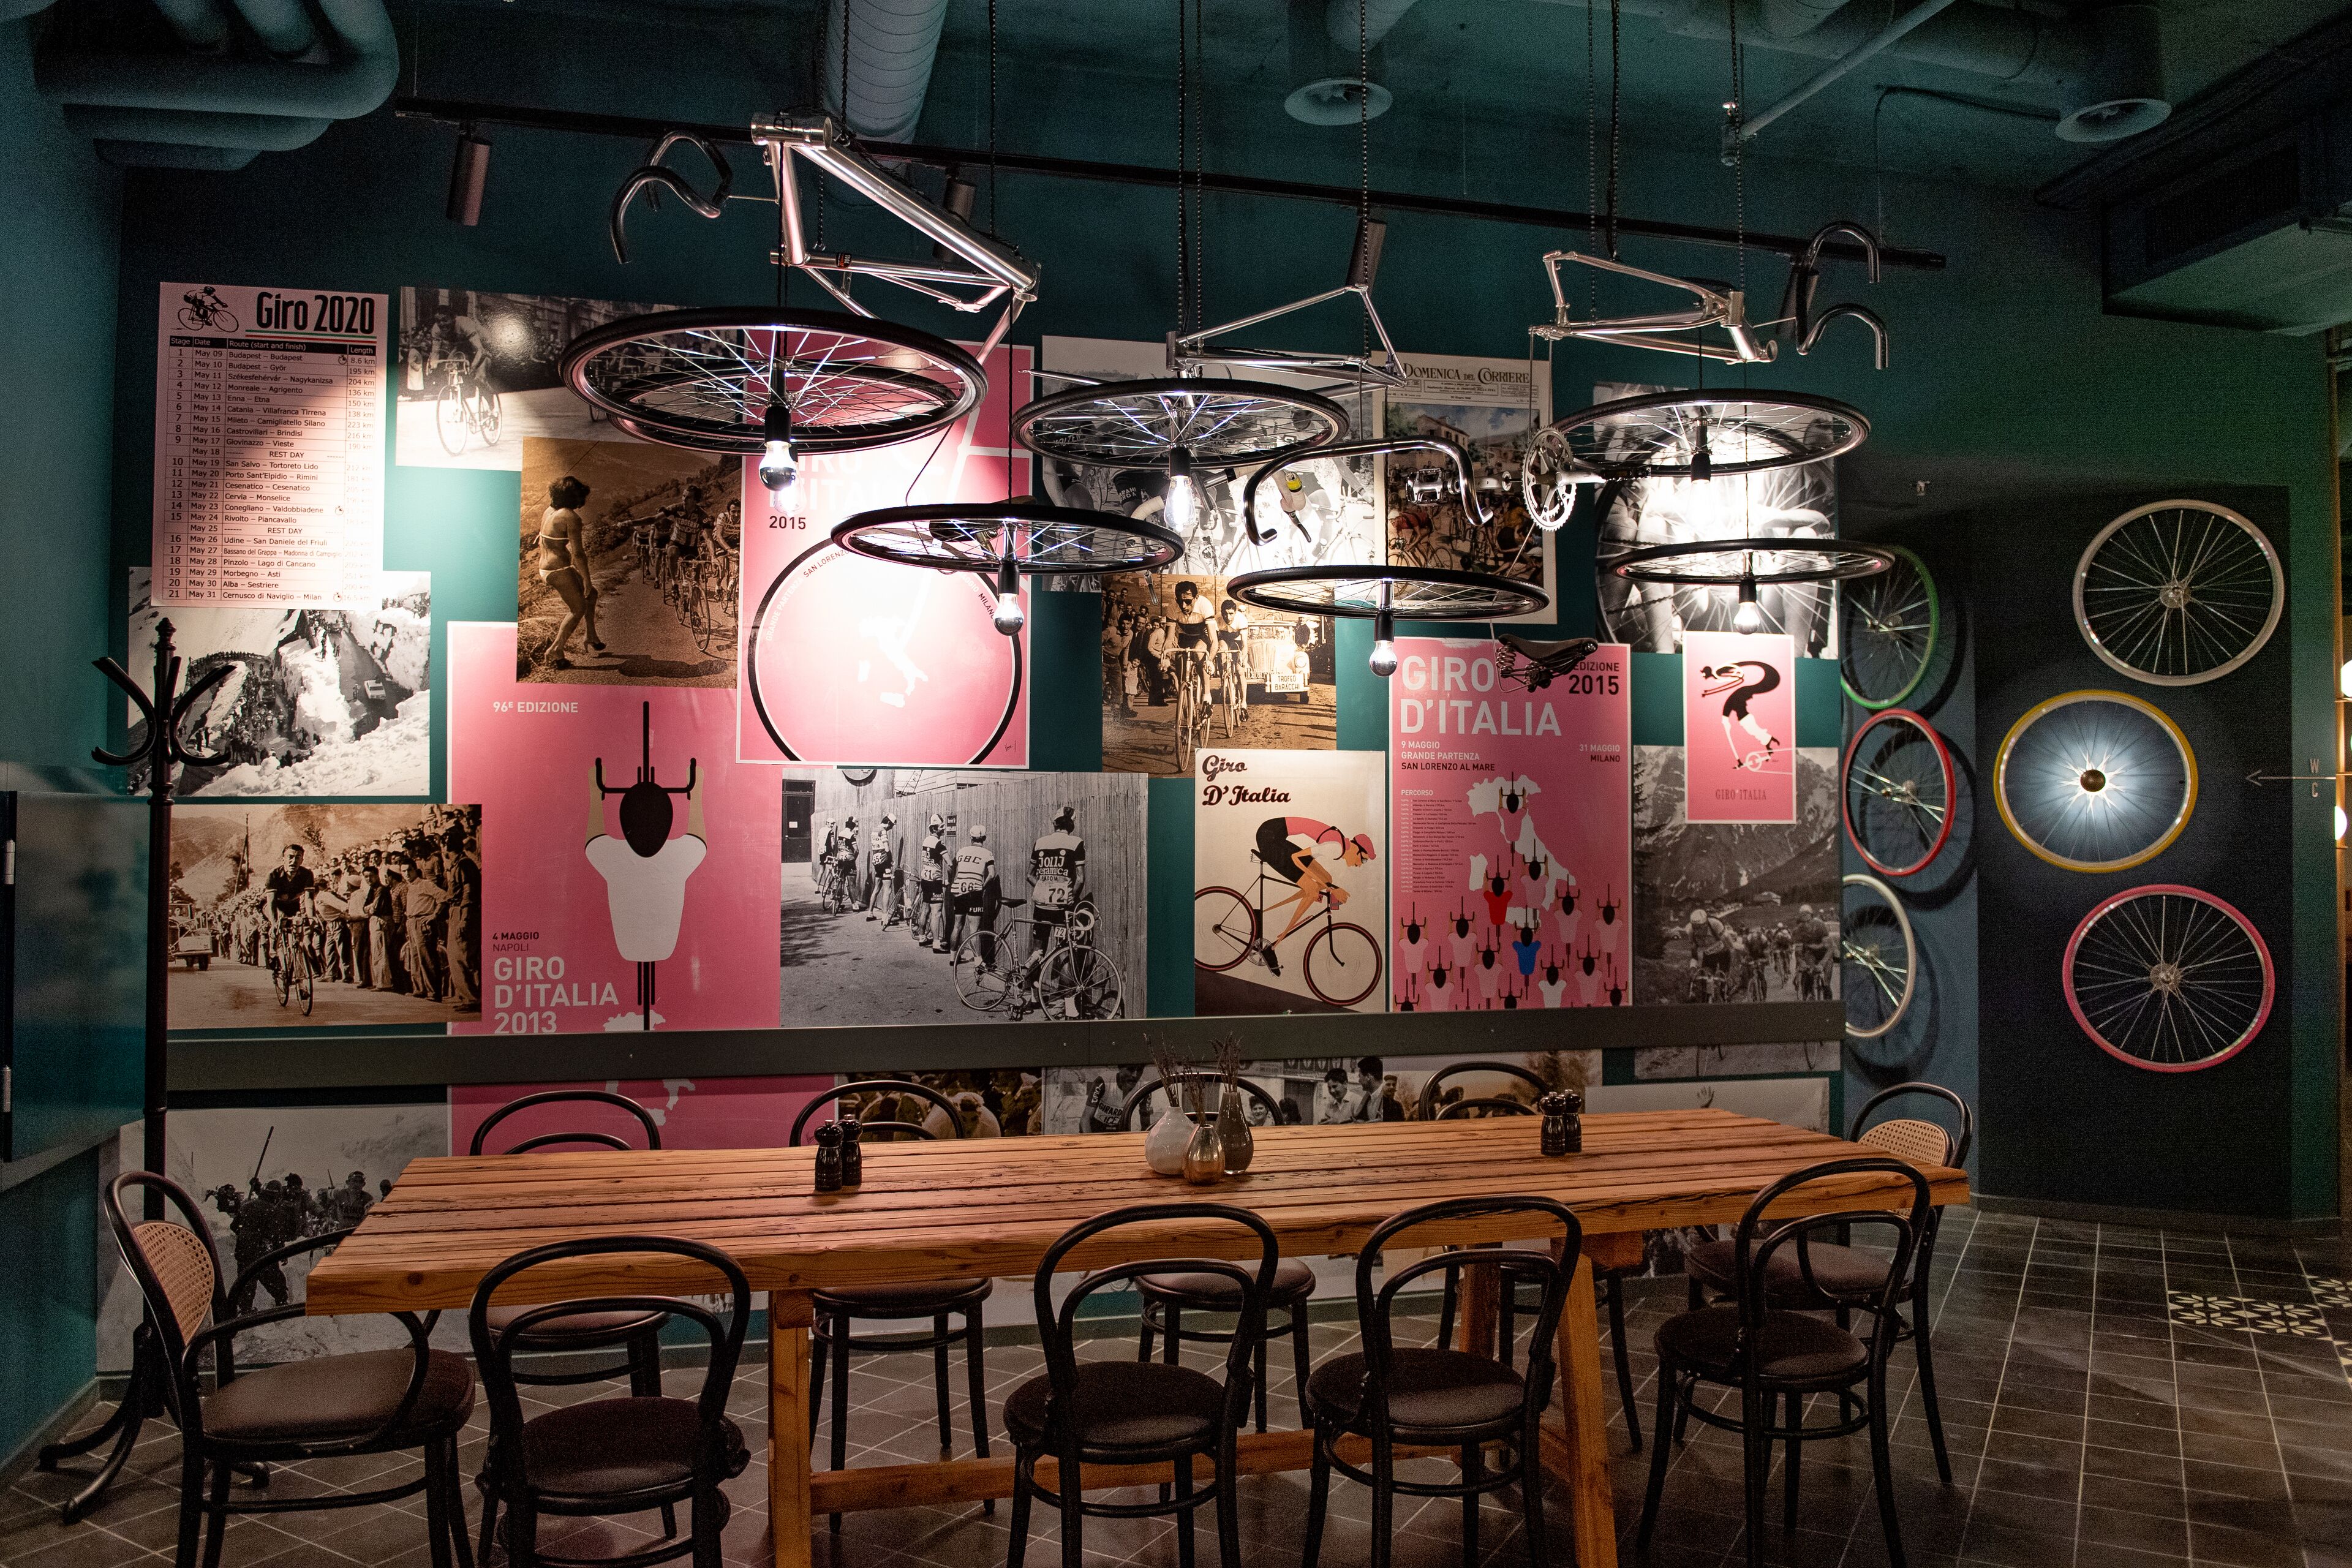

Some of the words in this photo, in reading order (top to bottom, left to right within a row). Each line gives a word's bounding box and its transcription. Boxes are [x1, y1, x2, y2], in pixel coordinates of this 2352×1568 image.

[256, 291, 309, 331] Giro
[314, 294, 375, 334] 2020
[171, 337, 190, 347] Stage
[195, 360, 210, 369] May
[194, 371, 209, 379] May
[1403, 363, 1460, 380] DOMENICA
[1478, 367, 1529, 384] CORRIERE
[290, 375, 333, 384] Nagykanizsa
[194, 382, 209, 390] May
[194, 393, 209, 401] May
[192, 436, 208, 445] May
[192, 447, 208, 456] May
[769, 516, 806, 530] 2015
[766, 610, 781, 641] GRANDE
[803, 564, 818, 578] SAN
[1574, 662, 1620, 672] EDIZIONE
[1403, 655, 1494, 693] GIRO
[1569, 675, 1619, 695] 2015
[518, 702, 578, 713] EDIZIONE
[1400, 698, 1562, 736] D'ITALIA
[1401, 752, 1436, 760] GRANDE
[1438, 752, 1480, 761] PARTENZA
[1202, 755, 1248, 782] Giro
[1401, 762, 1419, 771] SAN
[1716, 789, 1736, 801] GIRO
[1739, 789, 1767, 800] ITALIA
[957, 855, 982, 864] GBC
[1048, 888, 1066, 903] 72
[501, 932, 540, 940] MAGGIO
[1055, 927, 1065, 937] 72
[492, 943, 529, 952] NAPOLI
[494, 956, 565, 981] GIRO
[494, 982, 619, 1008] D'ITALIA
[494, 1011, 557, 1034] 2013
